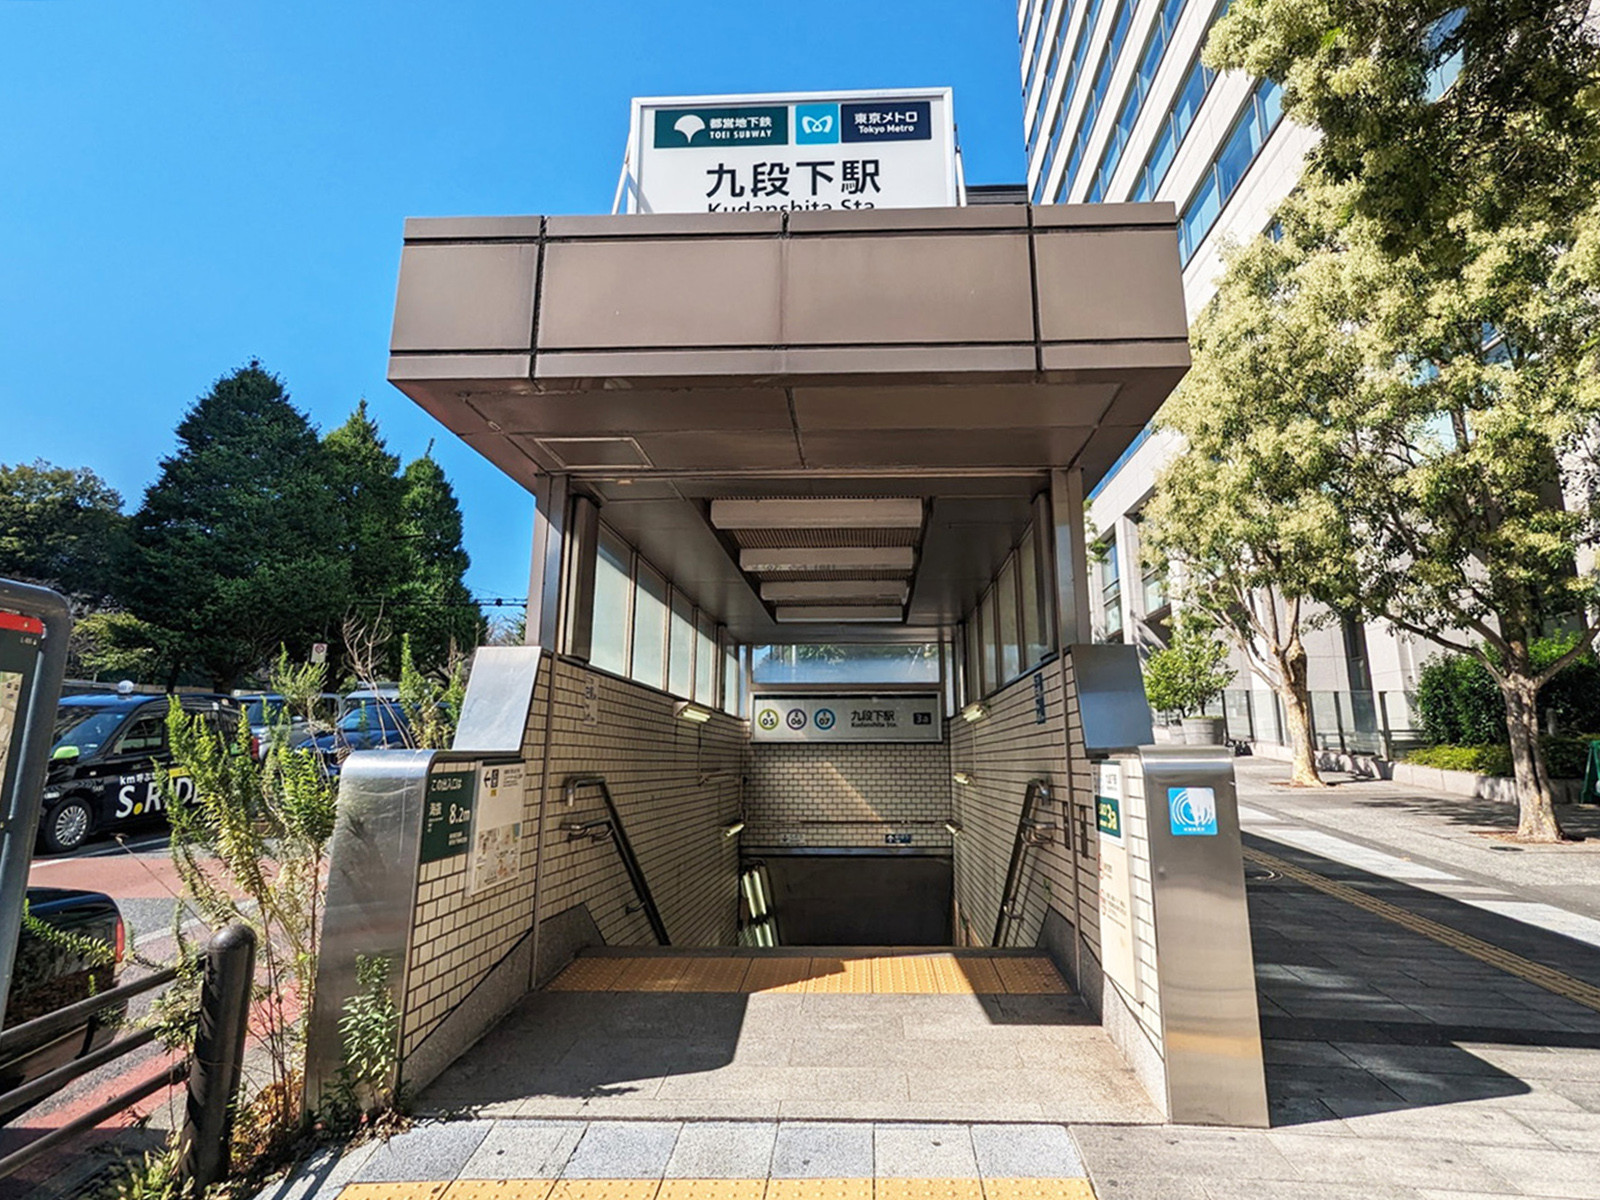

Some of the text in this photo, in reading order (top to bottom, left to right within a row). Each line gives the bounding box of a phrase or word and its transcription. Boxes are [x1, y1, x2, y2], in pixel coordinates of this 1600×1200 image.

[710, 116, 773, 129] 都営地下鉄
[854, 111, 918, 125] 東京メトロ
[710, 130, 772, 139] TOEI SUBWAY
[858, 124, 914, 134] Tokyo Metro
[706, 159, 881, 198] 九段下駅
[851, 710, 895, 721] 九段下駅
